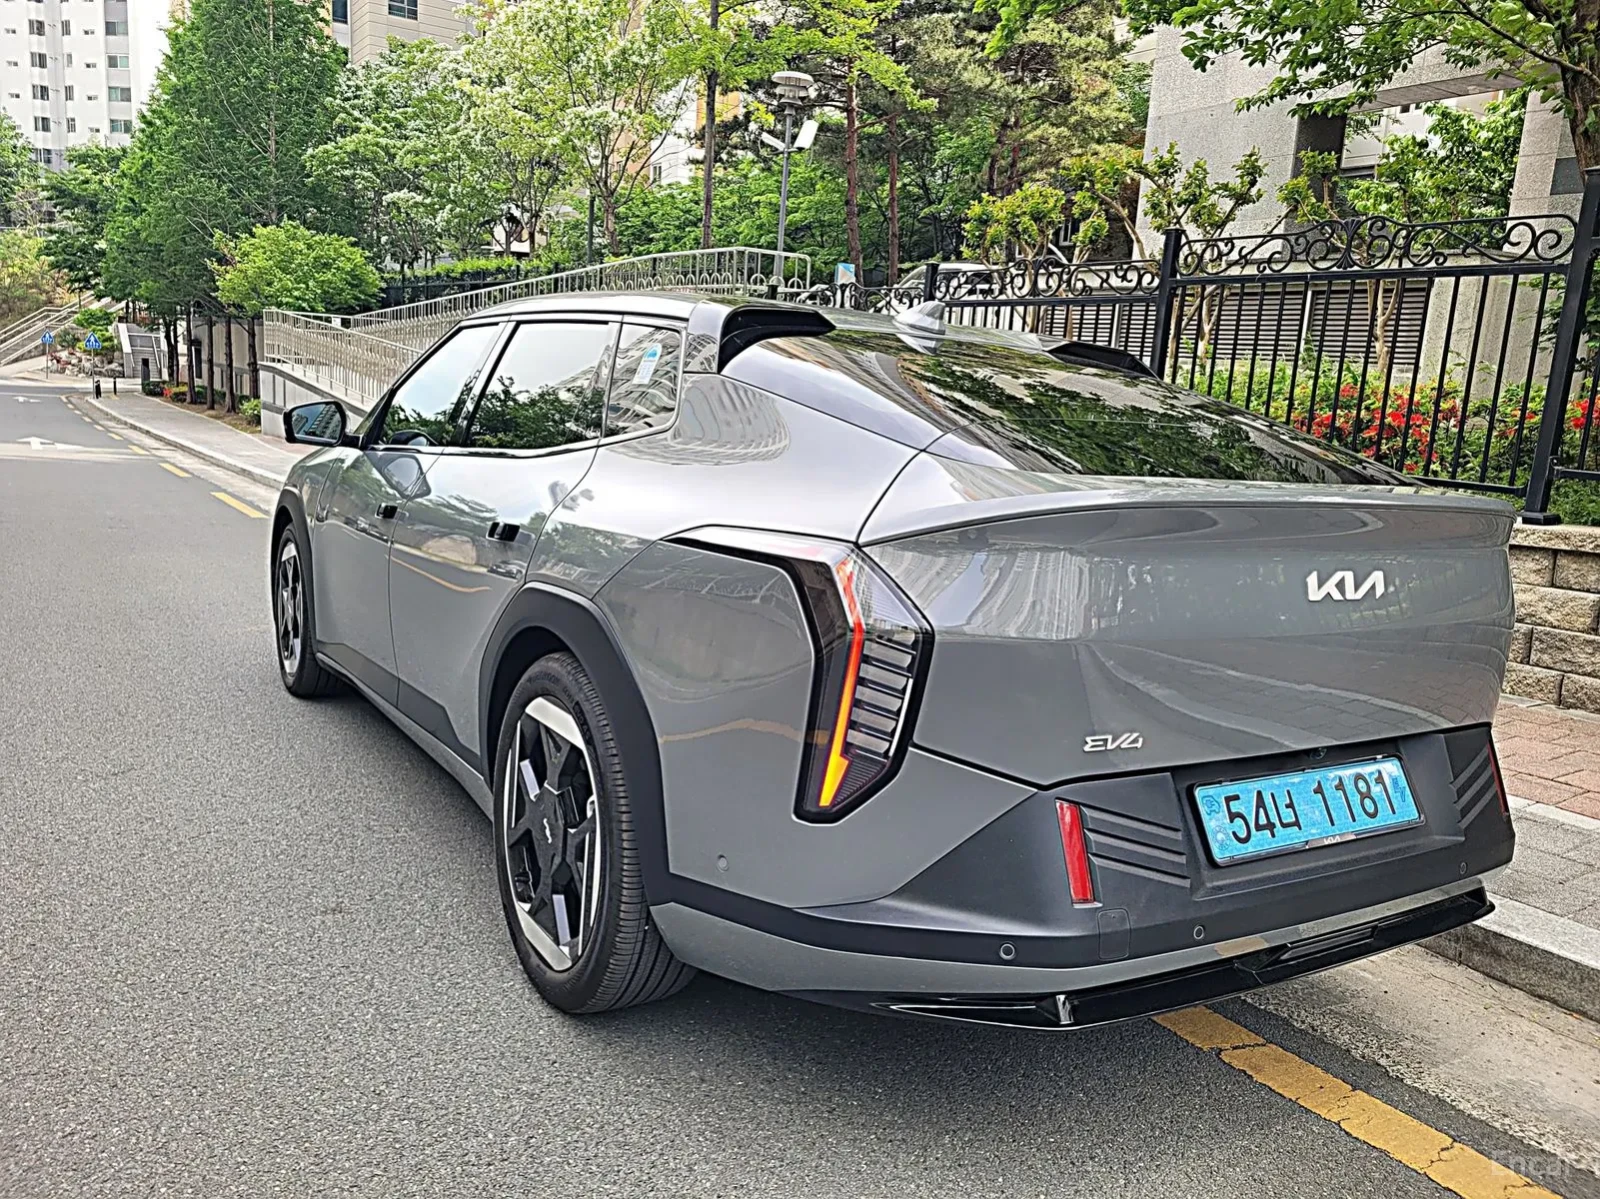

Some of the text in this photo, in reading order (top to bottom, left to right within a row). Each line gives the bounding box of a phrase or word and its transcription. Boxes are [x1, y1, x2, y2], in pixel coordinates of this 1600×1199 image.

[1306, 570, 1385, 601] KIA
[1083, 732, 1144, 752] EV4
[1222, 789, 1302, 845] 54너
[1313, 769, 1397, 827] 1181
